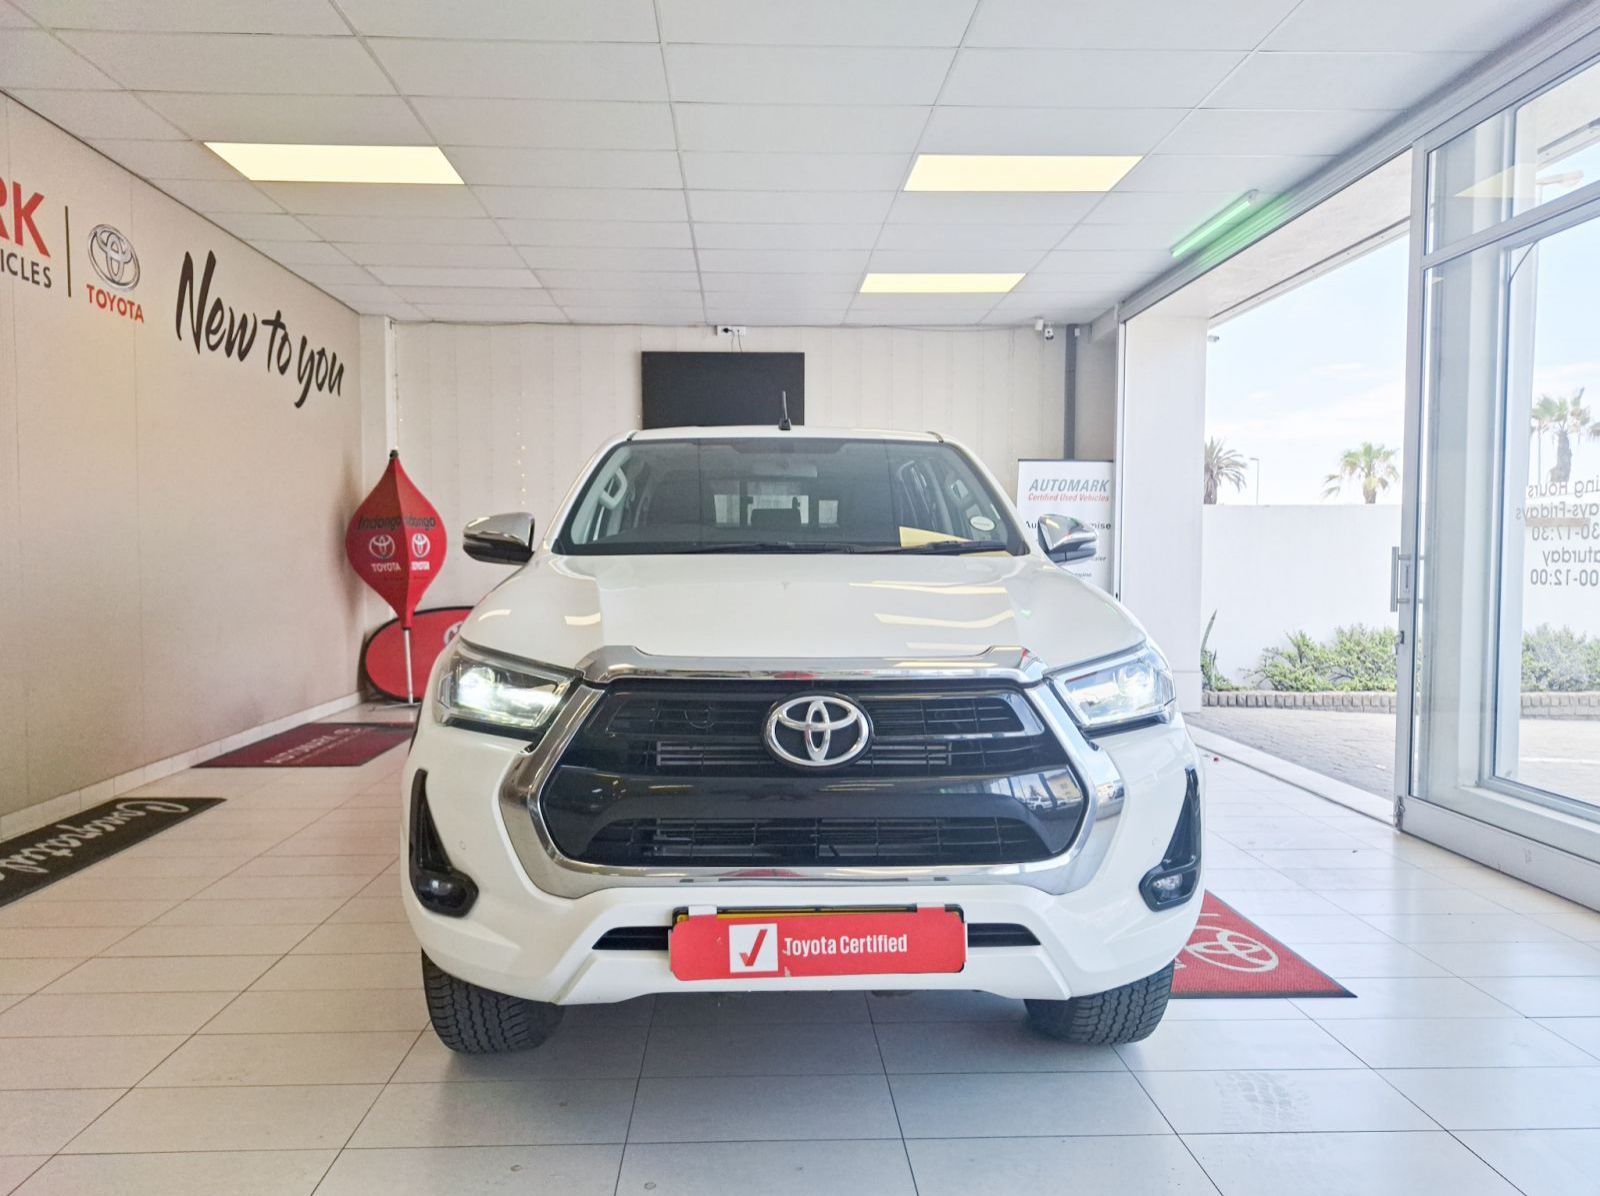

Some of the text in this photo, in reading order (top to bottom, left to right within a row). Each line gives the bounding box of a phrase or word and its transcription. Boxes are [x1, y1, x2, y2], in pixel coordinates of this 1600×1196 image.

[86, 284, 144, 323] TOYOTA
[175, 250, 345, 409] New to you
[1029, 478, 1110, 492] AUTOMARK
[1029, 492, 1109, 502] Certified Used Vehicles
[371, 563, 401, 572] TOYOTA
[784, 934, 907, 957] Toyota Certified
